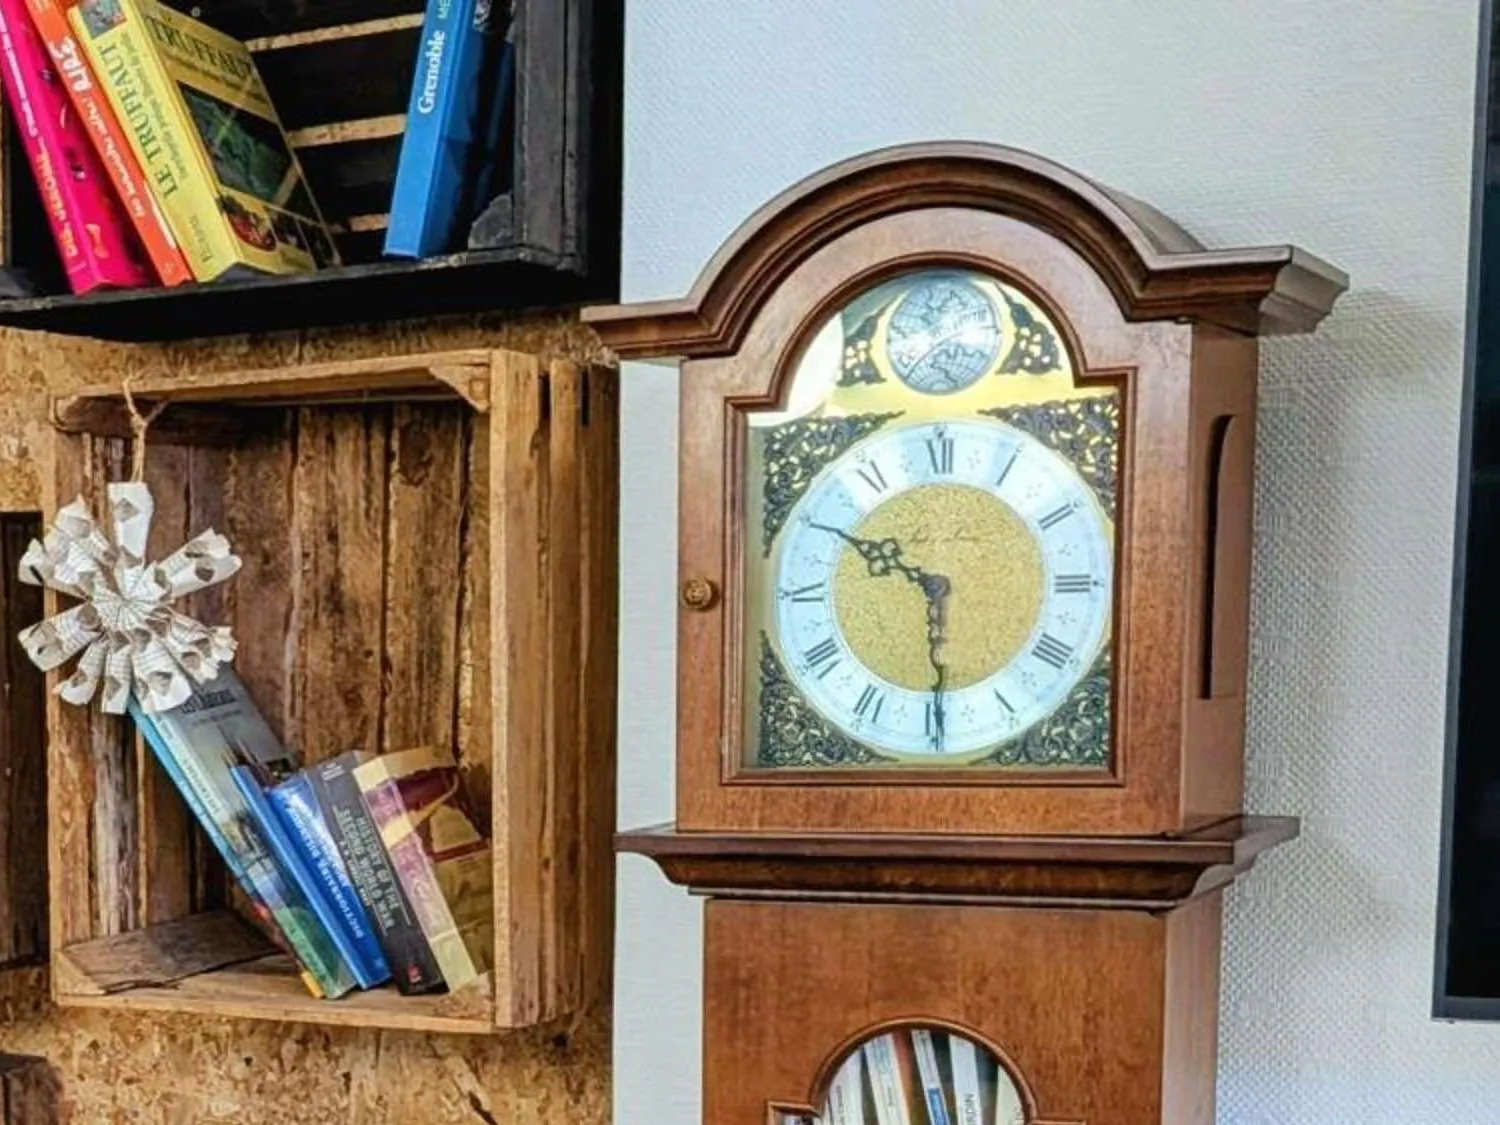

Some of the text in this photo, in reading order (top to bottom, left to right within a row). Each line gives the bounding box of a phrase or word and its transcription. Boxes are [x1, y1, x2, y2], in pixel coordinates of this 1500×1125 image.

[97, 41, 165, 164] TRUFFAUT
[418, 30, 445, 113] Grenoble
[152, 163, 179, 198] LE
[337, 808, 396, 930] SECOND WORLD WAR
[352, 813, 385, 867] HISTORY
[382, 887, 402, 911] THE
